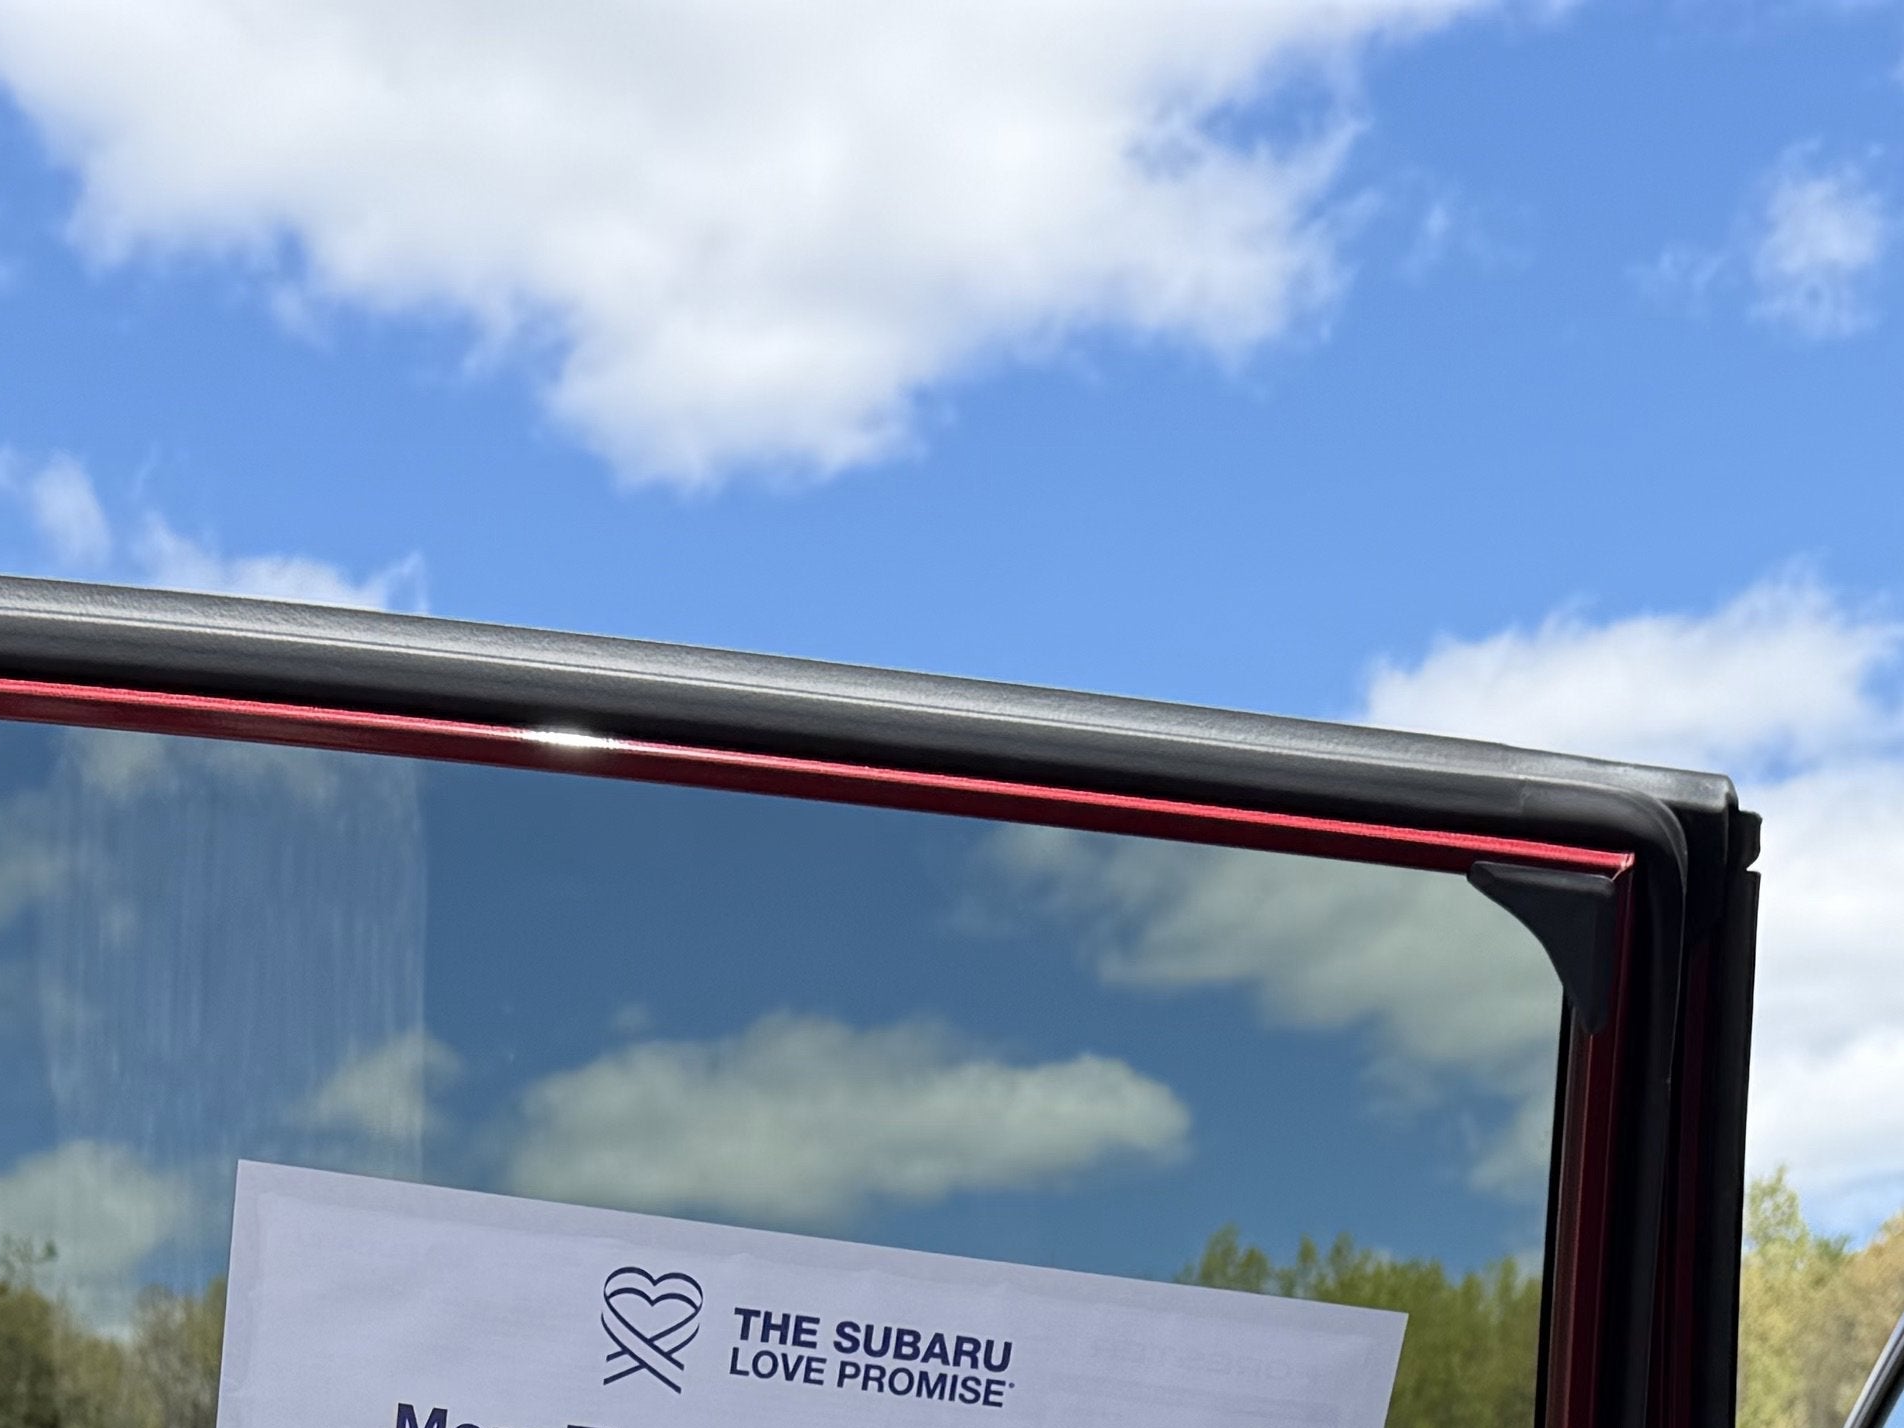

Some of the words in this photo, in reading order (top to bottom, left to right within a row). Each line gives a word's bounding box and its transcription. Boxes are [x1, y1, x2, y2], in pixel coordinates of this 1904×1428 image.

[733, 1306, 821, 1350] THE
[832, 1320, 1013, 1373] SUBARU
[729, 1346, 827, 1386] LOVE
[836, 1360, 1006, 1408] PROMISE
